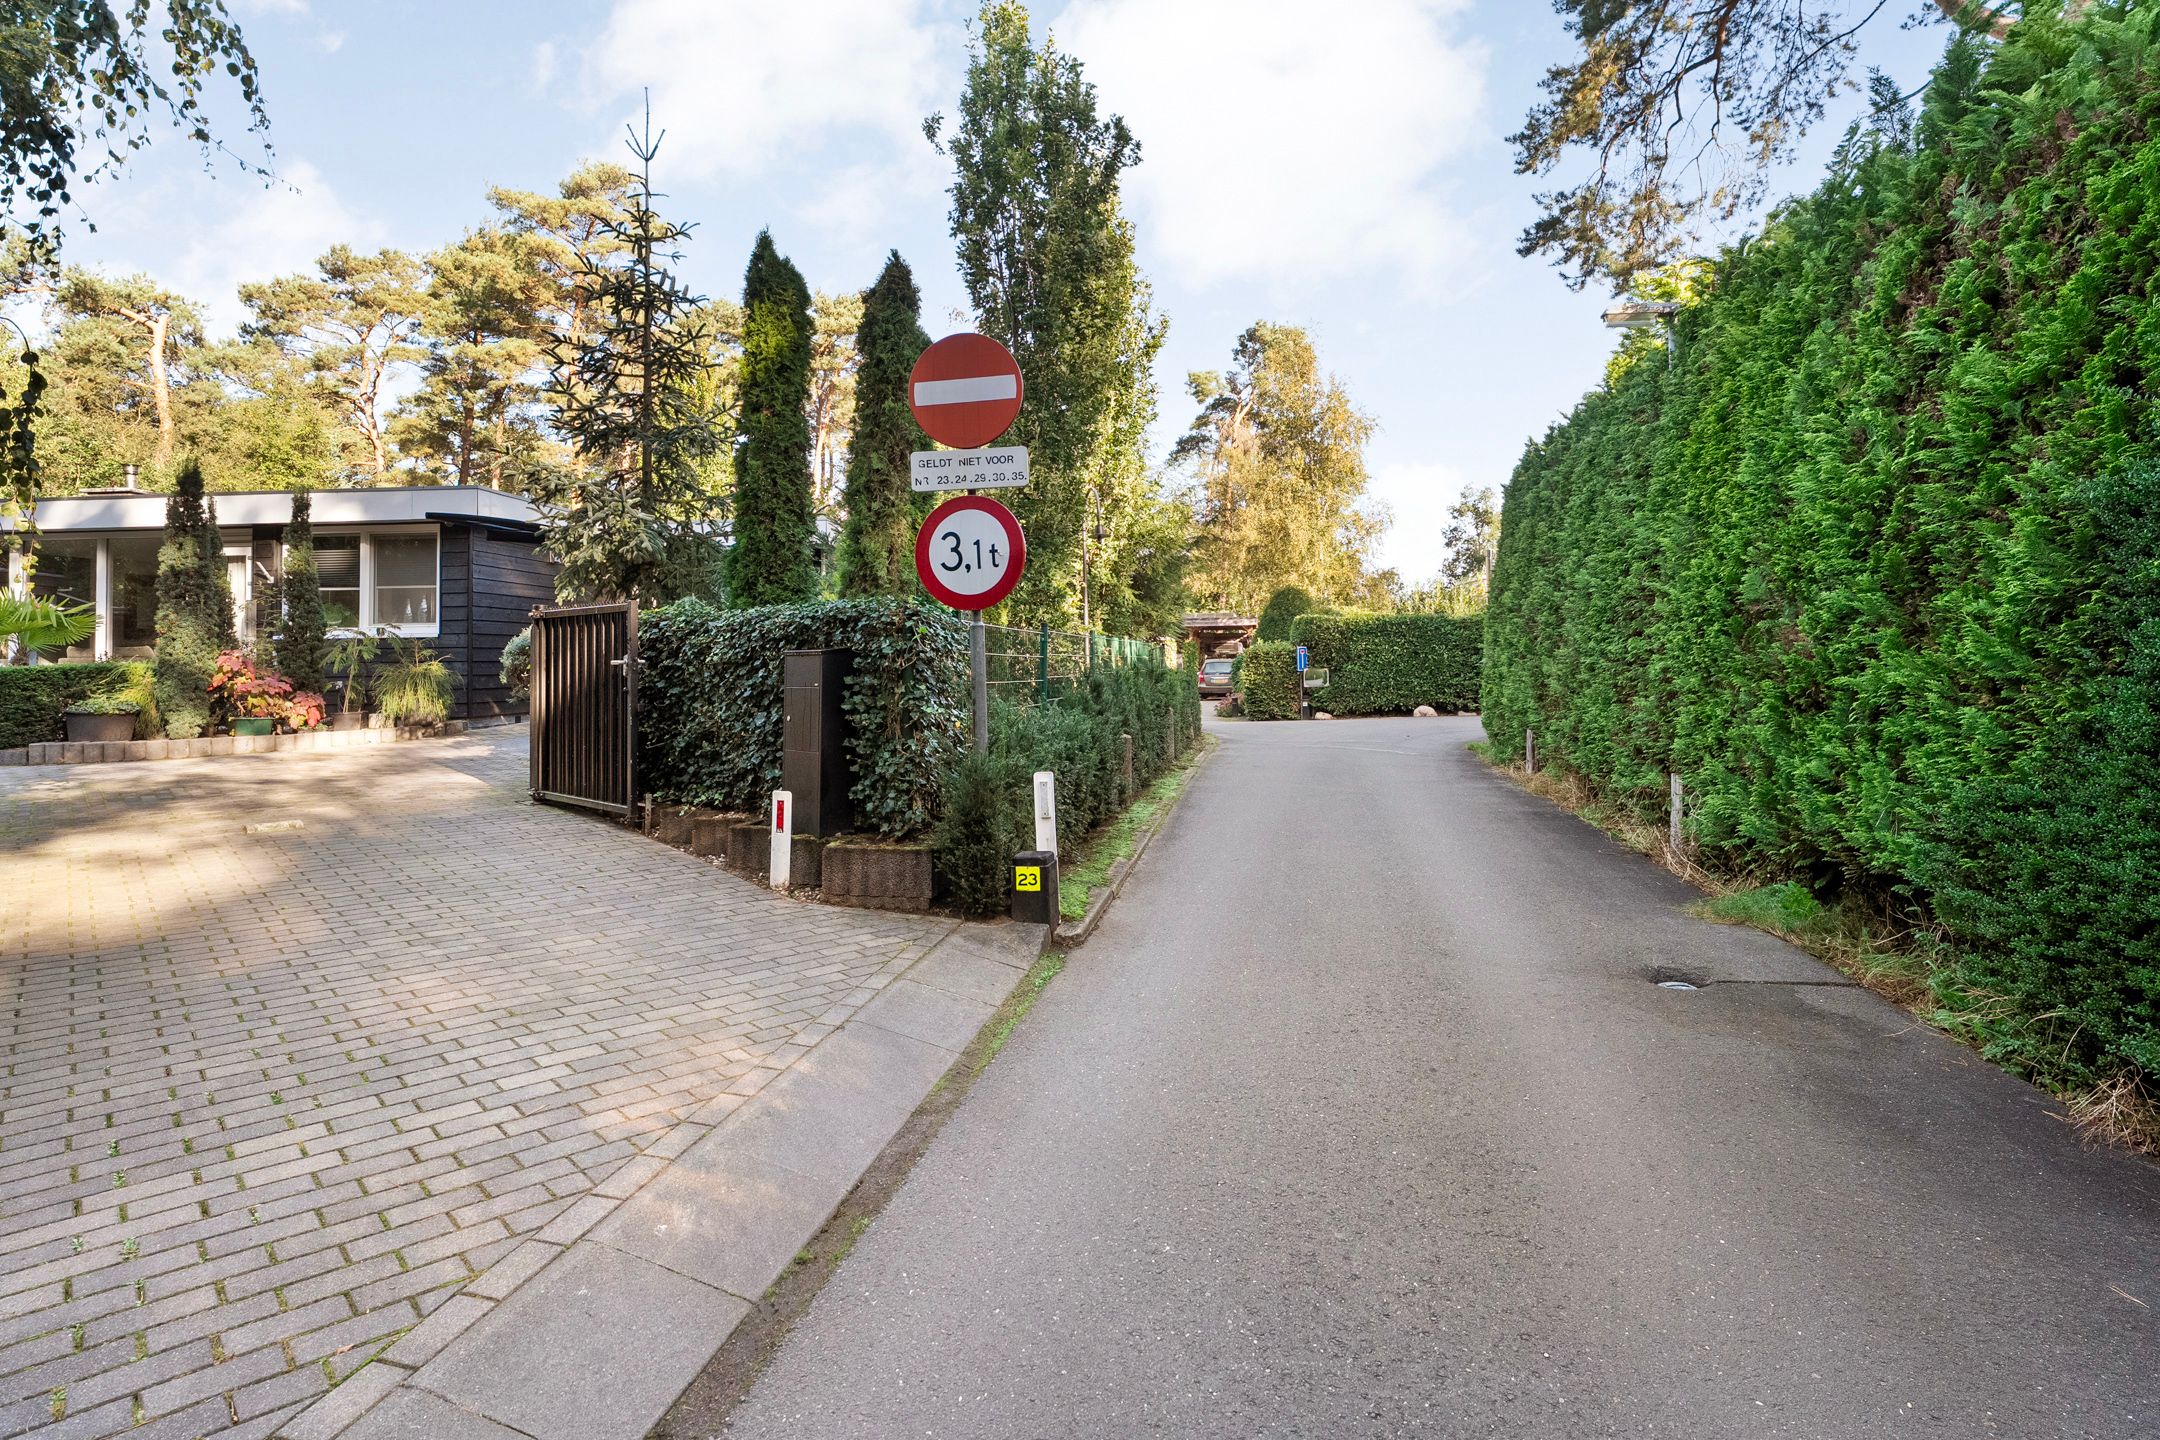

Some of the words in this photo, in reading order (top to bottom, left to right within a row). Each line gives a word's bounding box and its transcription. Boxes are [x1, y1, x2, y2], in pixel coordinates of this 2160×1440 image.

[918, 458, 953, 468] GELDT
[958, 456, 982, 467] NIET
[985, 455, 1014, 465] VOOR
[1018, 873, 1038, 886] 23
